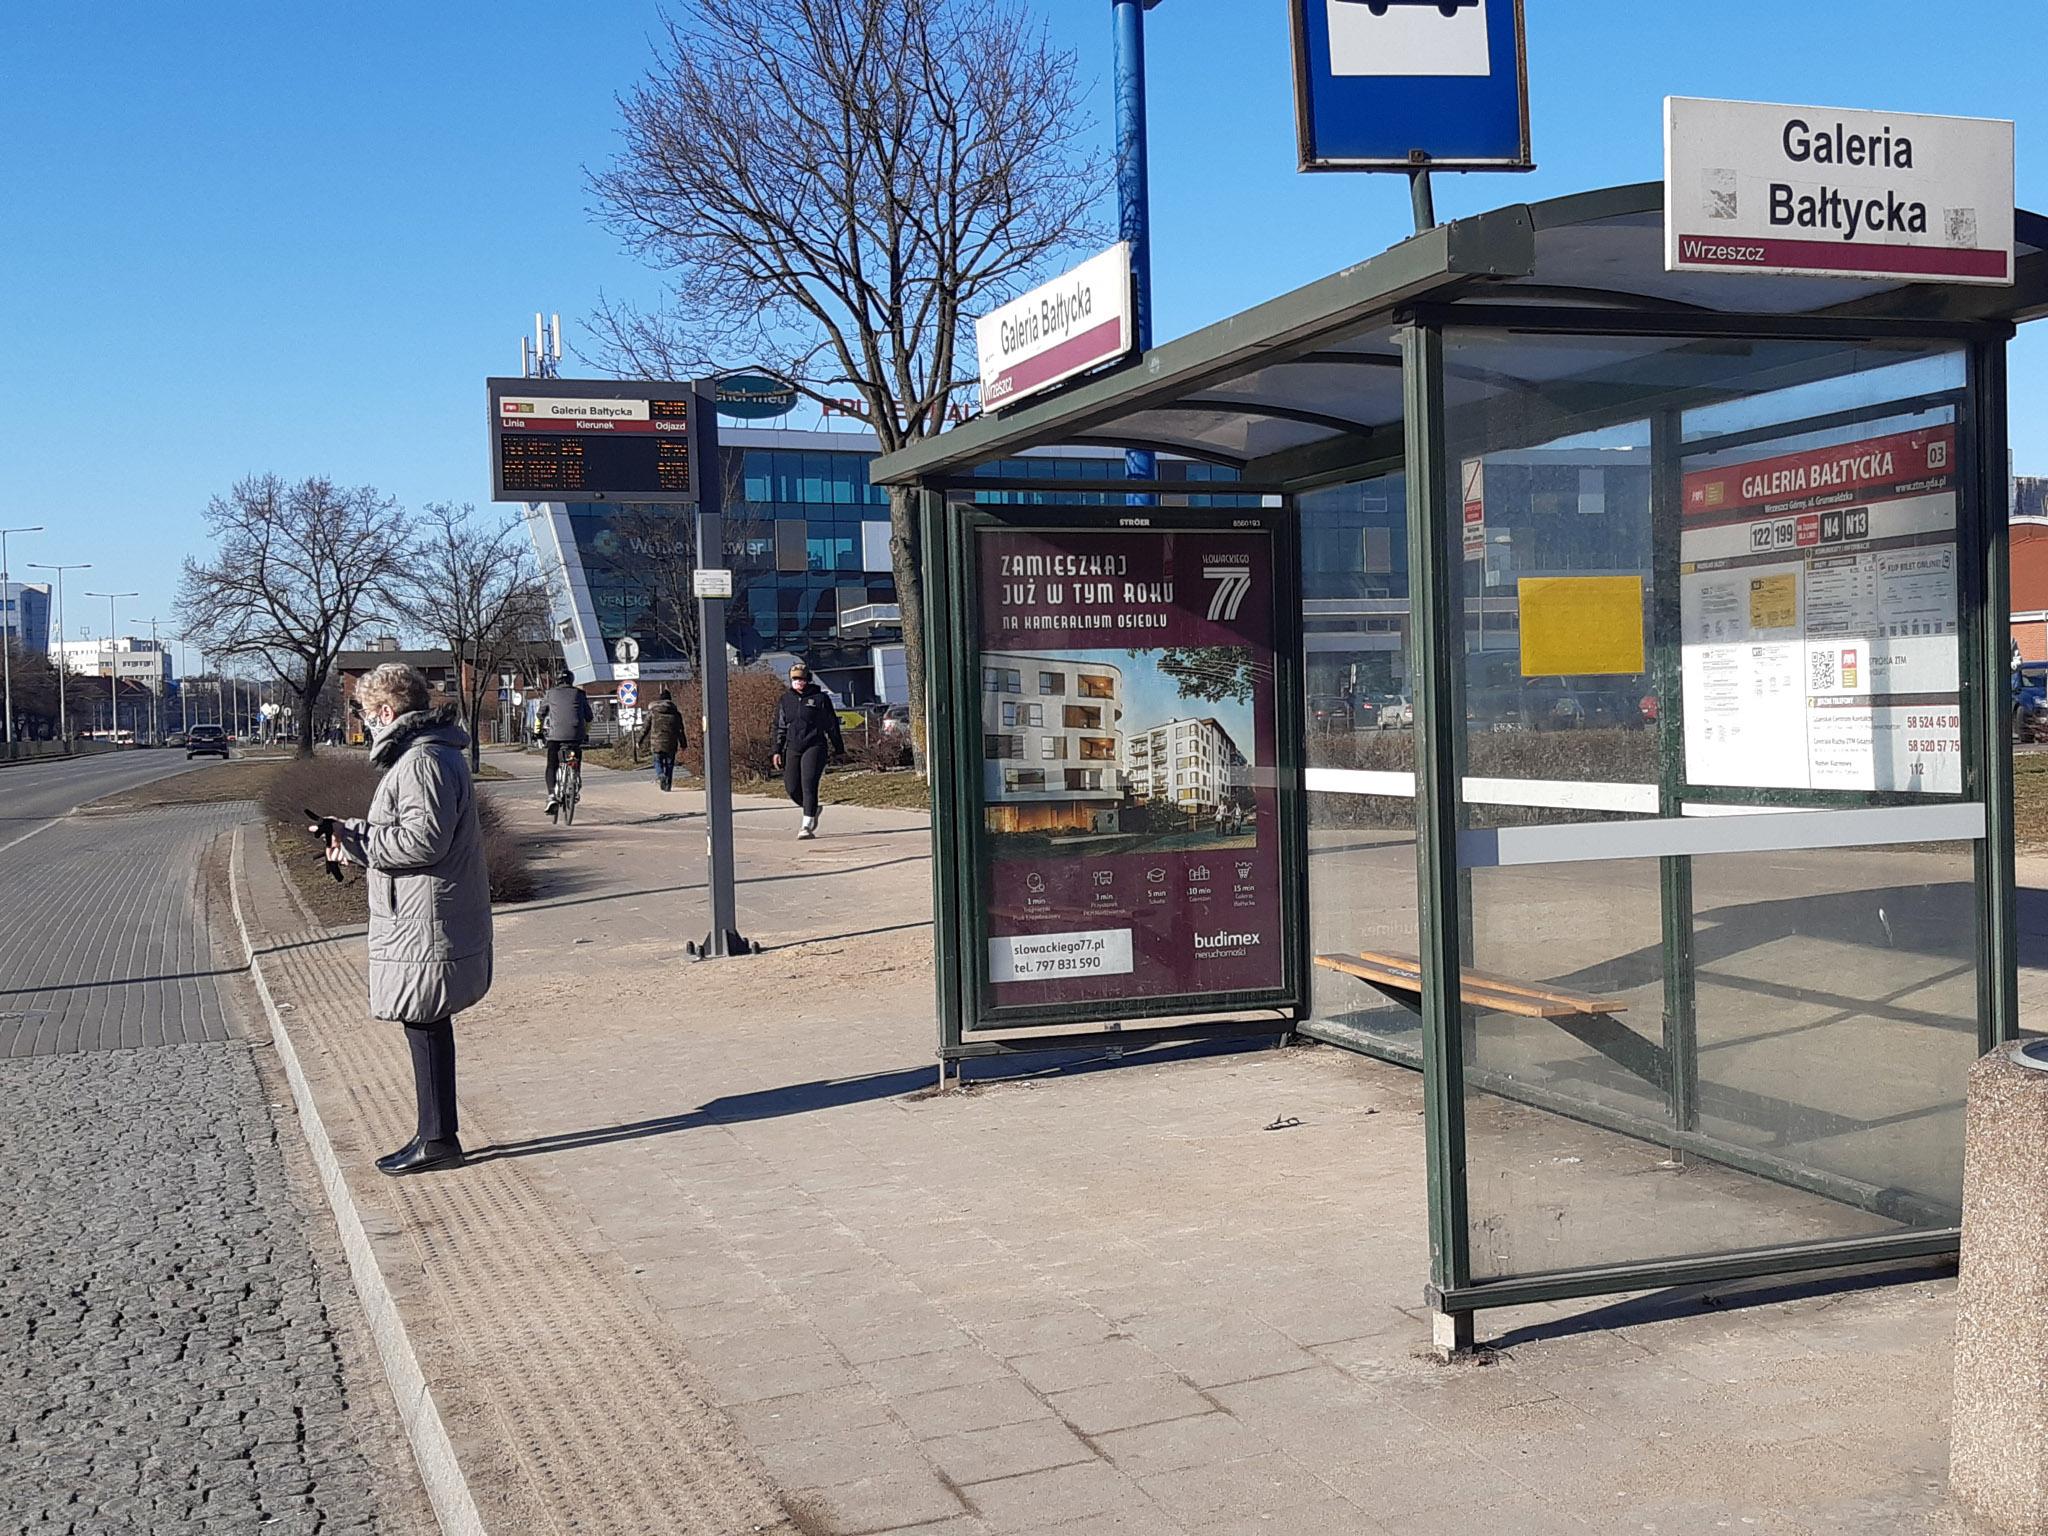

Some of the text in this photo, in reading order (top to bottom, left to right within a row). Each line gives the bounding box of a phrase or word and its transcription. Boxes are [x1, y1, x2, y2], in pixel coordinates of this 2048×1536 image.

[1782, 119, 1914, 169] Galeria
[1768, 183, 1928, 241] Bałtycka
[1683, 240, 1765, 262] Wrzeszcz
[1000, 281, 1092, 356] Galeria Bałtycka
[982, 377, 1014, 402] Wrzeszcz
[551, 404, 633, 417] Galeria Bałtycka
[502, 419, 687, 432] Linia Kierunek Odjazd
[1930, 446, 1944, 464] 03
[1742, 468, 1807, 499] GALERIA
[1810, 451, 1894, 488] BAŁTYCKA
[1119, 518, 1150, 526] STRÖER
[1824, 513, 1866, 538] N4 N13
[1753, 523, 1793, 547] 122 199
[1000, 555, 1128, 577] ZAMIESZKAJ
[1001, 578, 1174, 605] JUŻ W TYM ROKU
[1202, 567, 1251, 621] 77
[1002, 613, 1168, 630] NA KAMERALNYM OSIEDLU
[1907, 716, 1917, 729] 58
[1920, 716, 1934, 729] 524
[1936, 715, 1946, 728] 45
[1948, 715, 1959, 728] 00
[1908, 739, 1960, 752] 58 520 57 75
[1909, 763, 1924, 775] 112
[1101, 893, 1113, 901] min
[1189, 887, 1198, 895] 10
[1013, 938, 1105, 956] slowackiego77.pl
[1194, 930, 1260, 948] budimex
[1014, 956, 1101, 974] tel. 797 831 590
